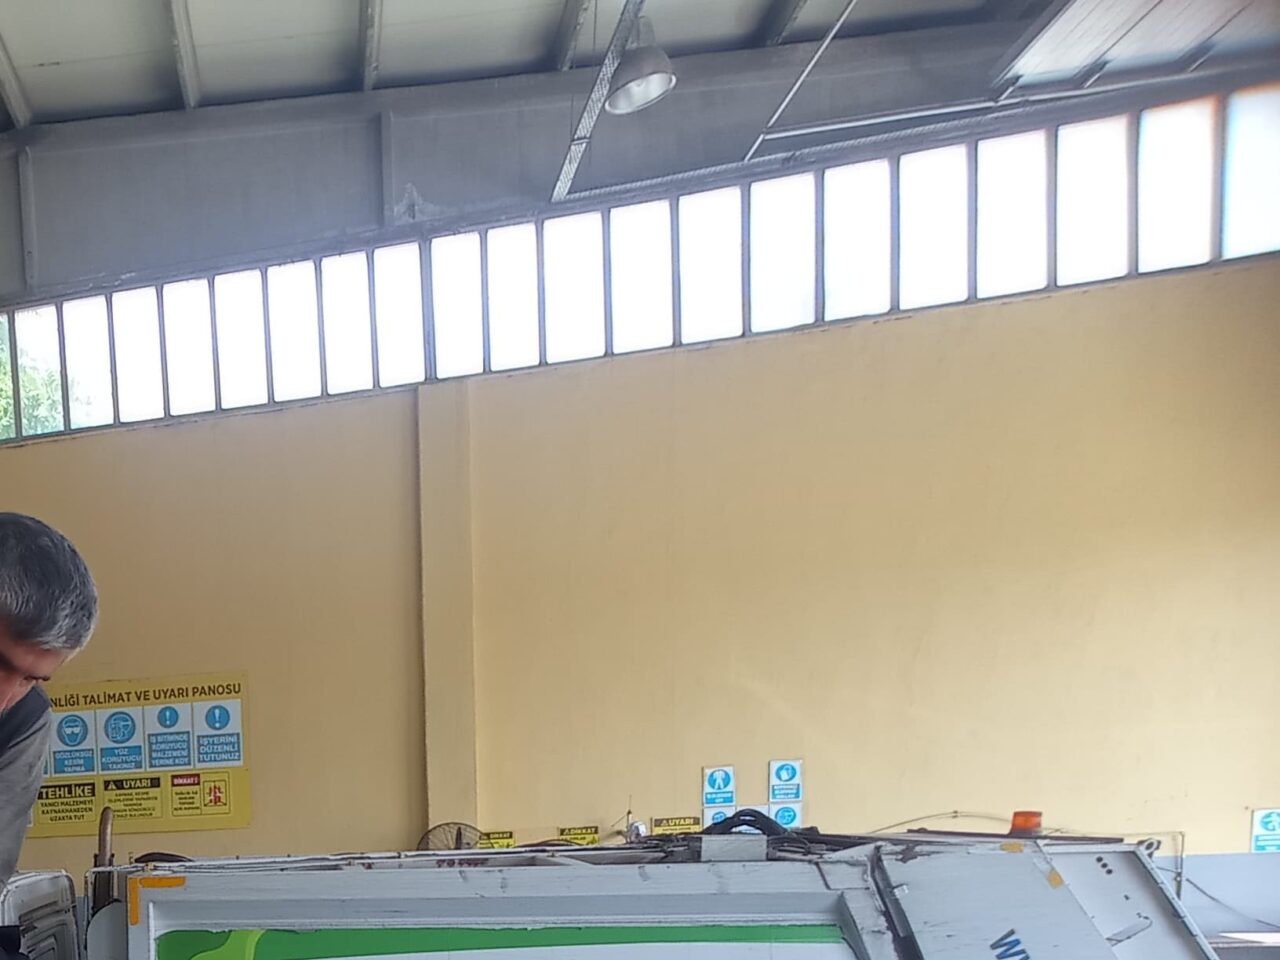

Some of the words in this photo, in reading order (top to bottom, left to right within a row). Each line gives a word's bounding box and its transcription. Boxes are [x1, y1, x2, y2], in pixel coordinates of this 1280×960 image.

[82, 690, 132, 706] TALİMAT
[134, 689, 150, 702] VE
[153, 686, 189, 700] UYARI
[192, 683, 241, 698] PANOSU
[199, 744, 238, 754] DÜZENLİ
[199, 753, 241, 762] TUTUNUZ
[122, 778, 151, 789] UYARI
[40, 784, 93, 799] TEHLİKE
[668, 817, 695, 827] UYARI
